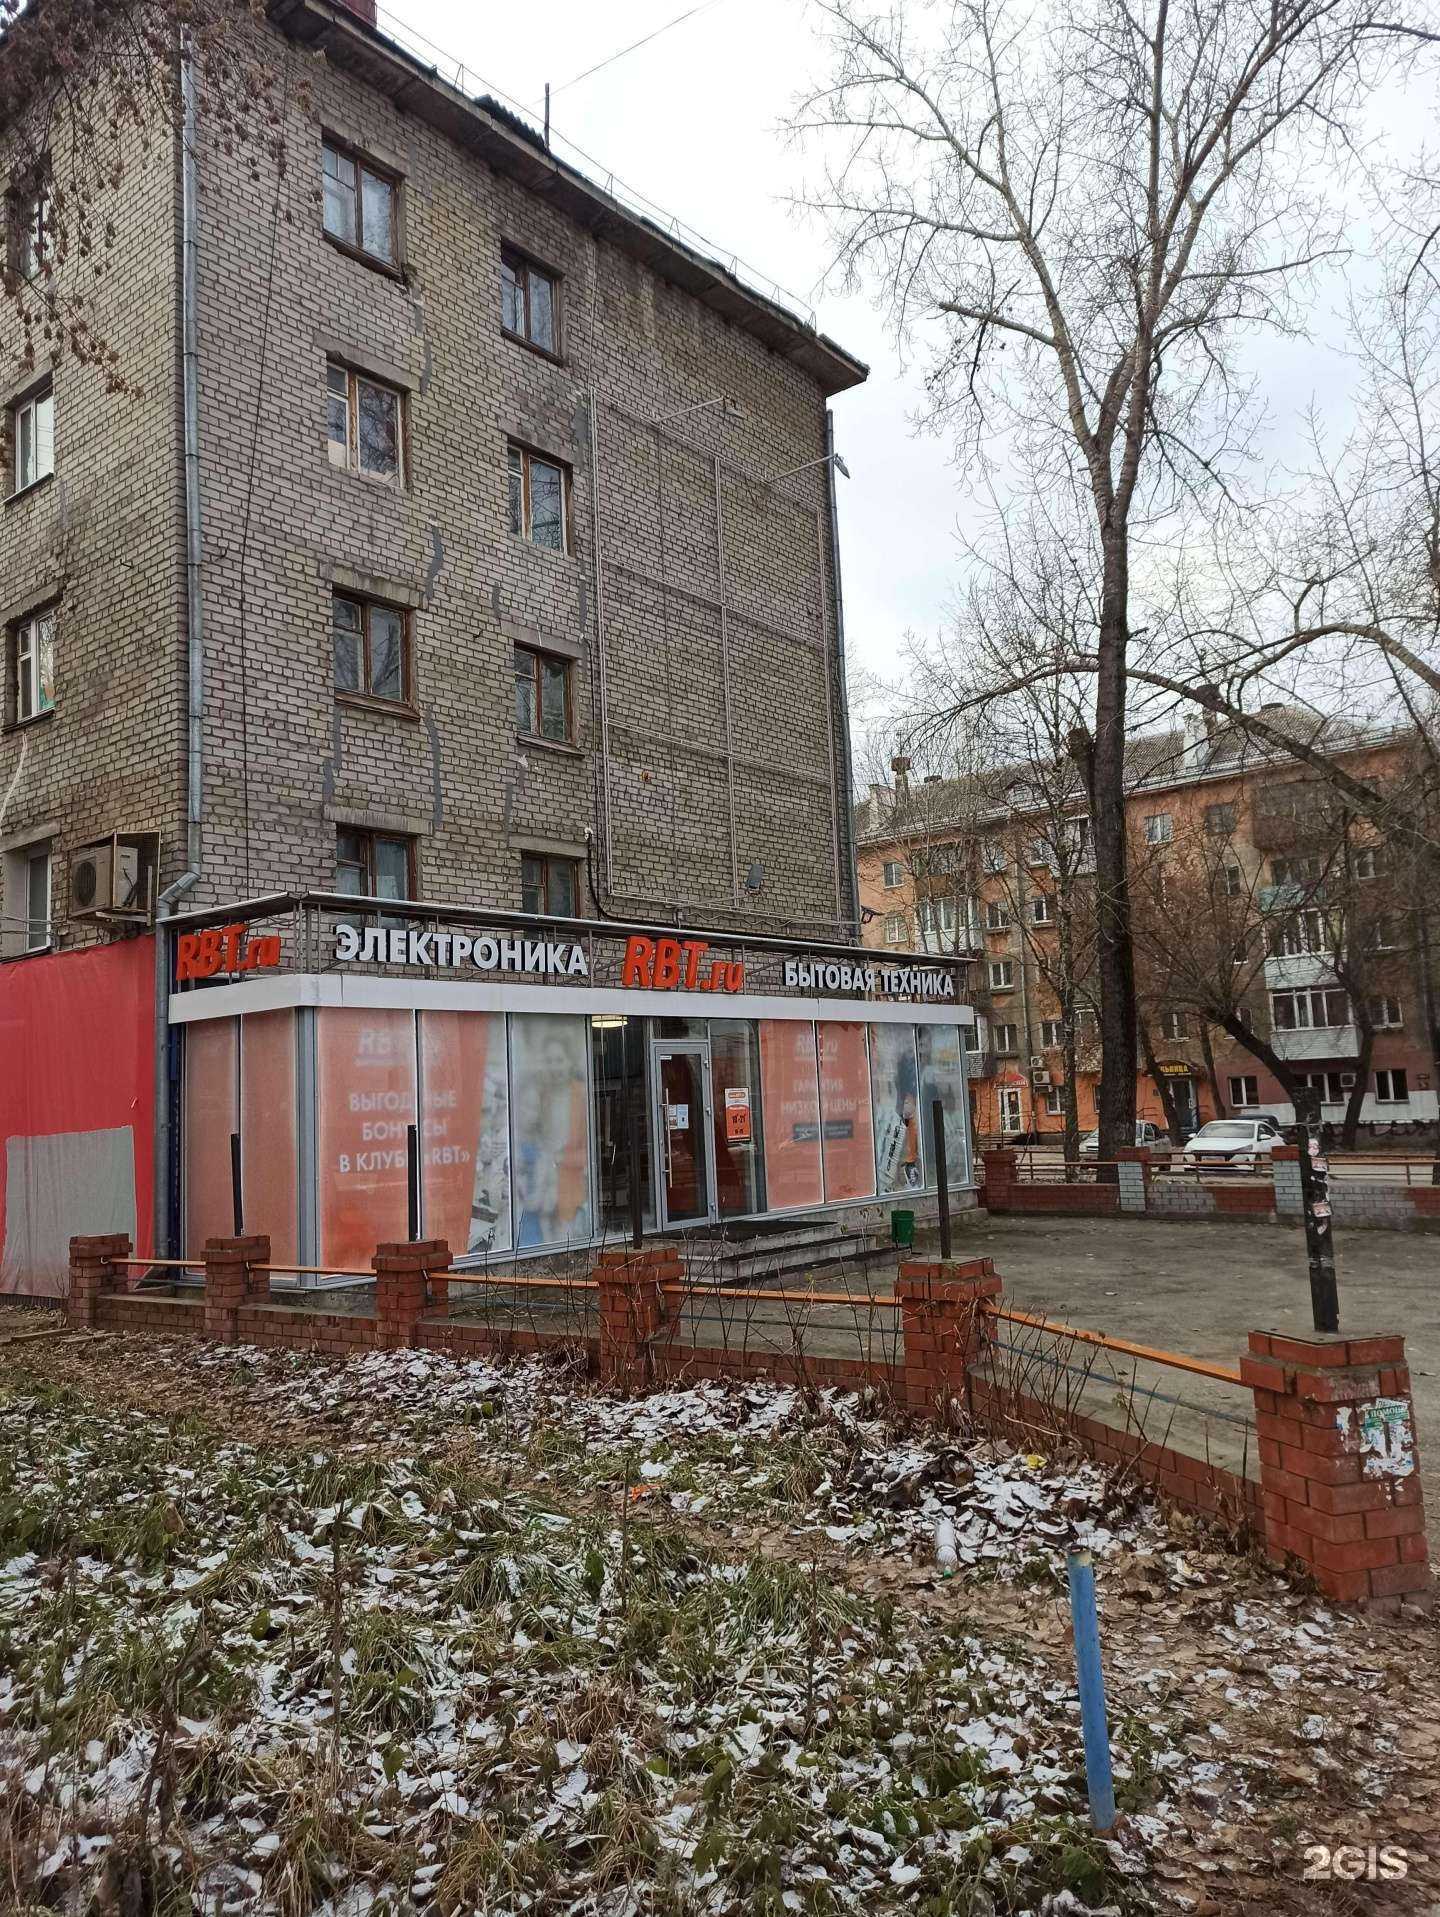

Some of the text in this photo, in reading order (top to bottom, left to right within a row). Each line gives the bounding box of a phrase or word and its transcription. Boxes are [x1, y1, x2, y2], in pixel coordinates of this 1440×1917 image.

[176, 923, 281, 980] RBT.ru
[335, 924, 589, 976] ЭЛЕКТРОНИКА
[622, 936, 744, 993] RBT.ru
[784, 961, 955, 996] БЫТОВАЯ ТЕХНИКА
[350, 1091, 457, 1112] ВЫГОДЫЕ
[339, 1154, 350, 1173] В
[356, 1150, 416, 1172] КЛУБ
